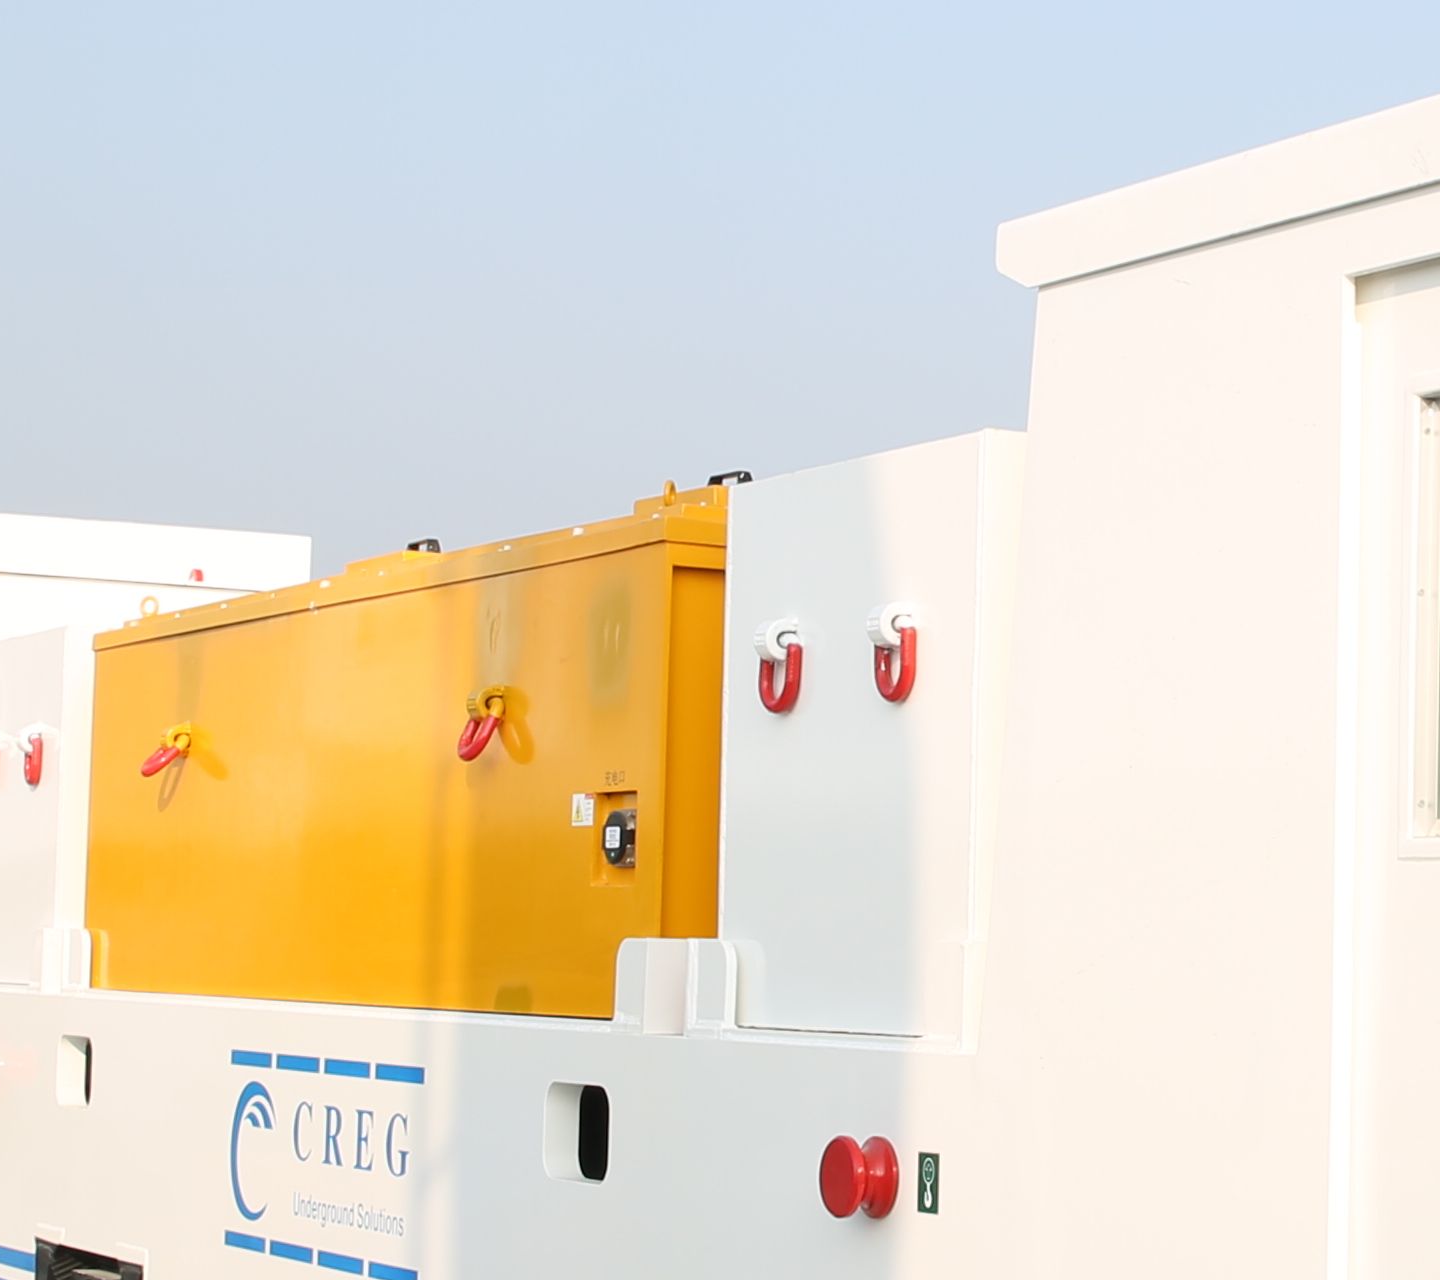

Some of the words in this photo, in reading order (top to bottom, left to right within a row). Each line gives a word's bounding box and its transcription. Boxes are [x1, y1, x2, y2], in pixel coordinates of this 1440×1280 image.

[293, 1100, 410, 1178] CREG
[292, 1191, 355, 1228] Underground
[357, 1202, 405, 1238] Solutions
